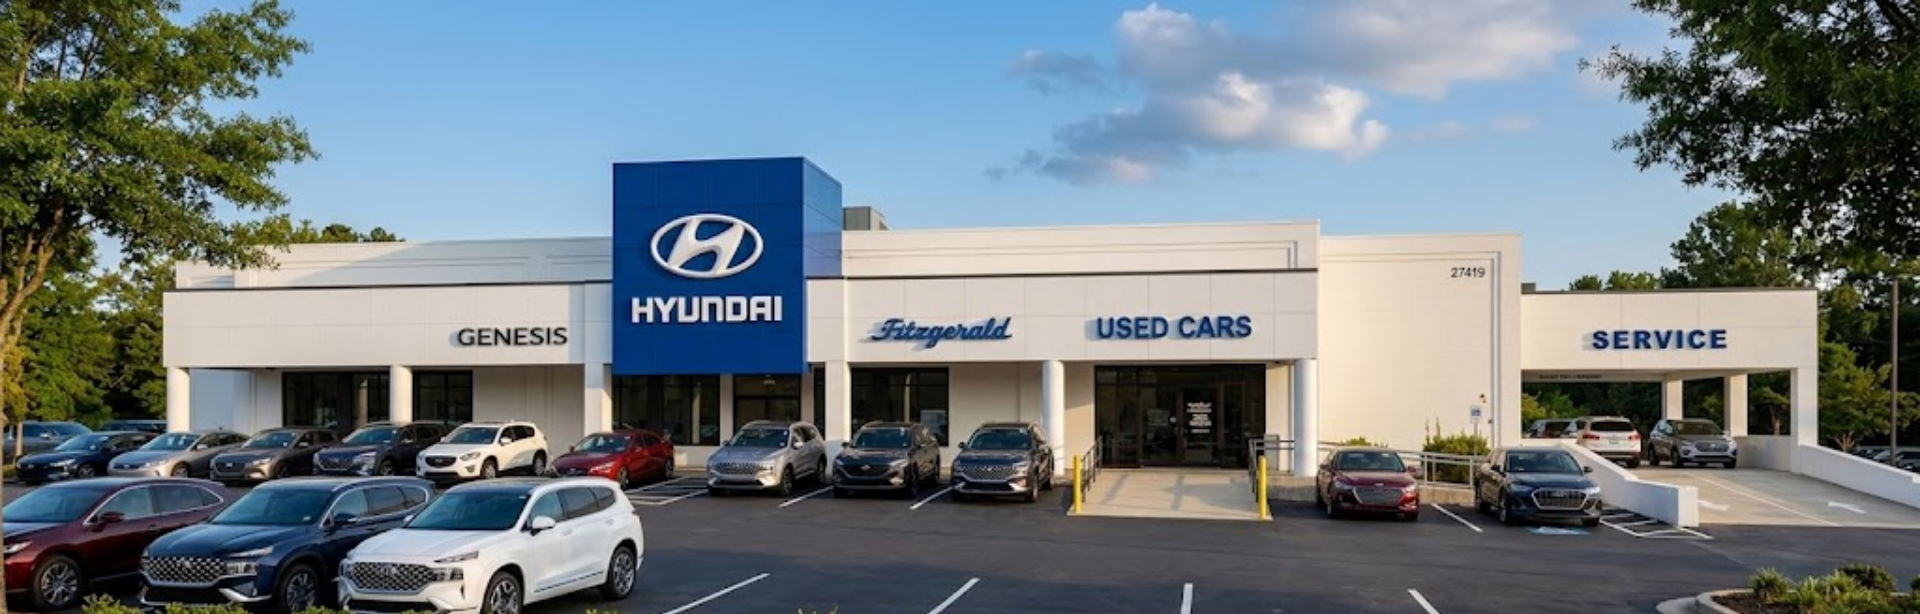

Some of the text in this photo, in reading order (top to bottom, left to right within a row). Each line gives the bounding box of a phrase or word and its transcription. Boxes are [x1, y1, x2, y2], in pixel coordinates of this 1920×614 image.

[1451, 267, 1486, 278] 27419
[631, 296, 782, 323] HYUNDAI
[457, 327, 568, 346] GENESIS
[871, 317, 1012, 348] Fitzgerald
[1096, 316, 1252, 339] USED CARS
[1593, 329, 1727, 350] SERVICE
